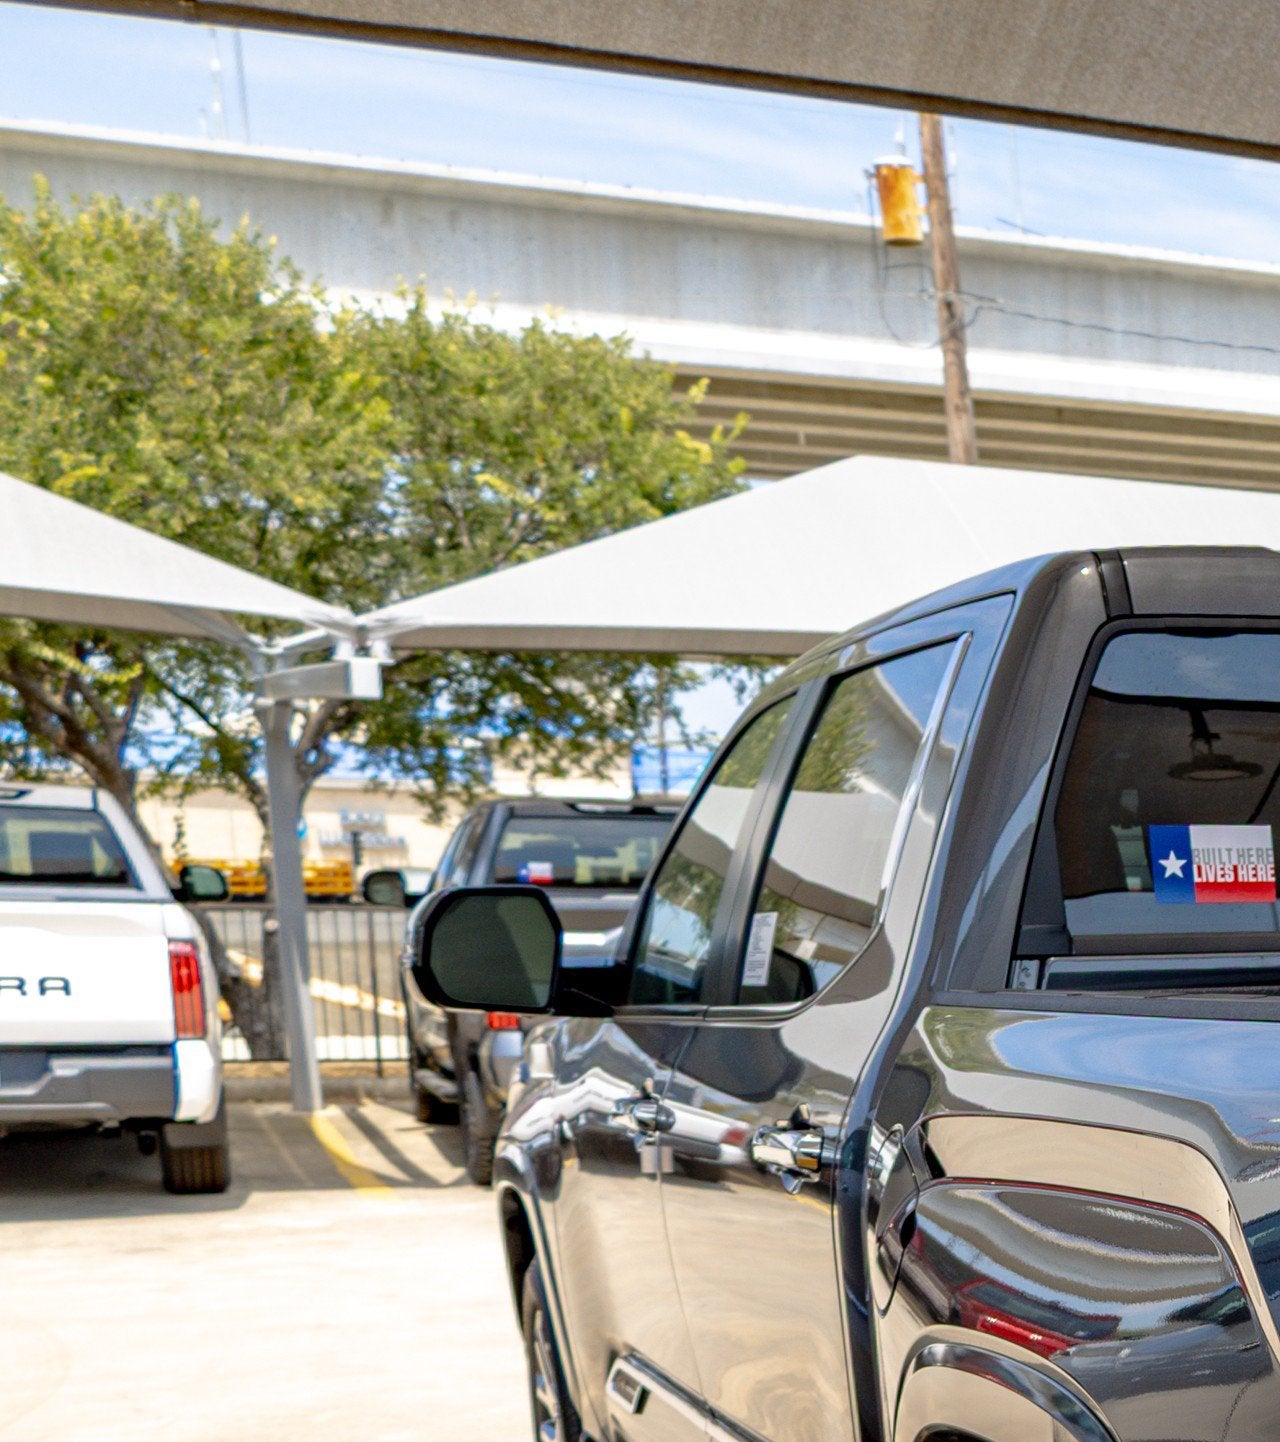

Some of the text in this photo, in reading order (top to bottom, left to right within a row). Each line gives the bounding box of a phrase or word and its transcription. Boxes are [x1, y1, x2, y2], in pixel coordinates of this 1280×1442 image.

[1193, 847, 1275, 865] BUILT HERE
[1194, 864, 1276, 883] LIVES HERE
